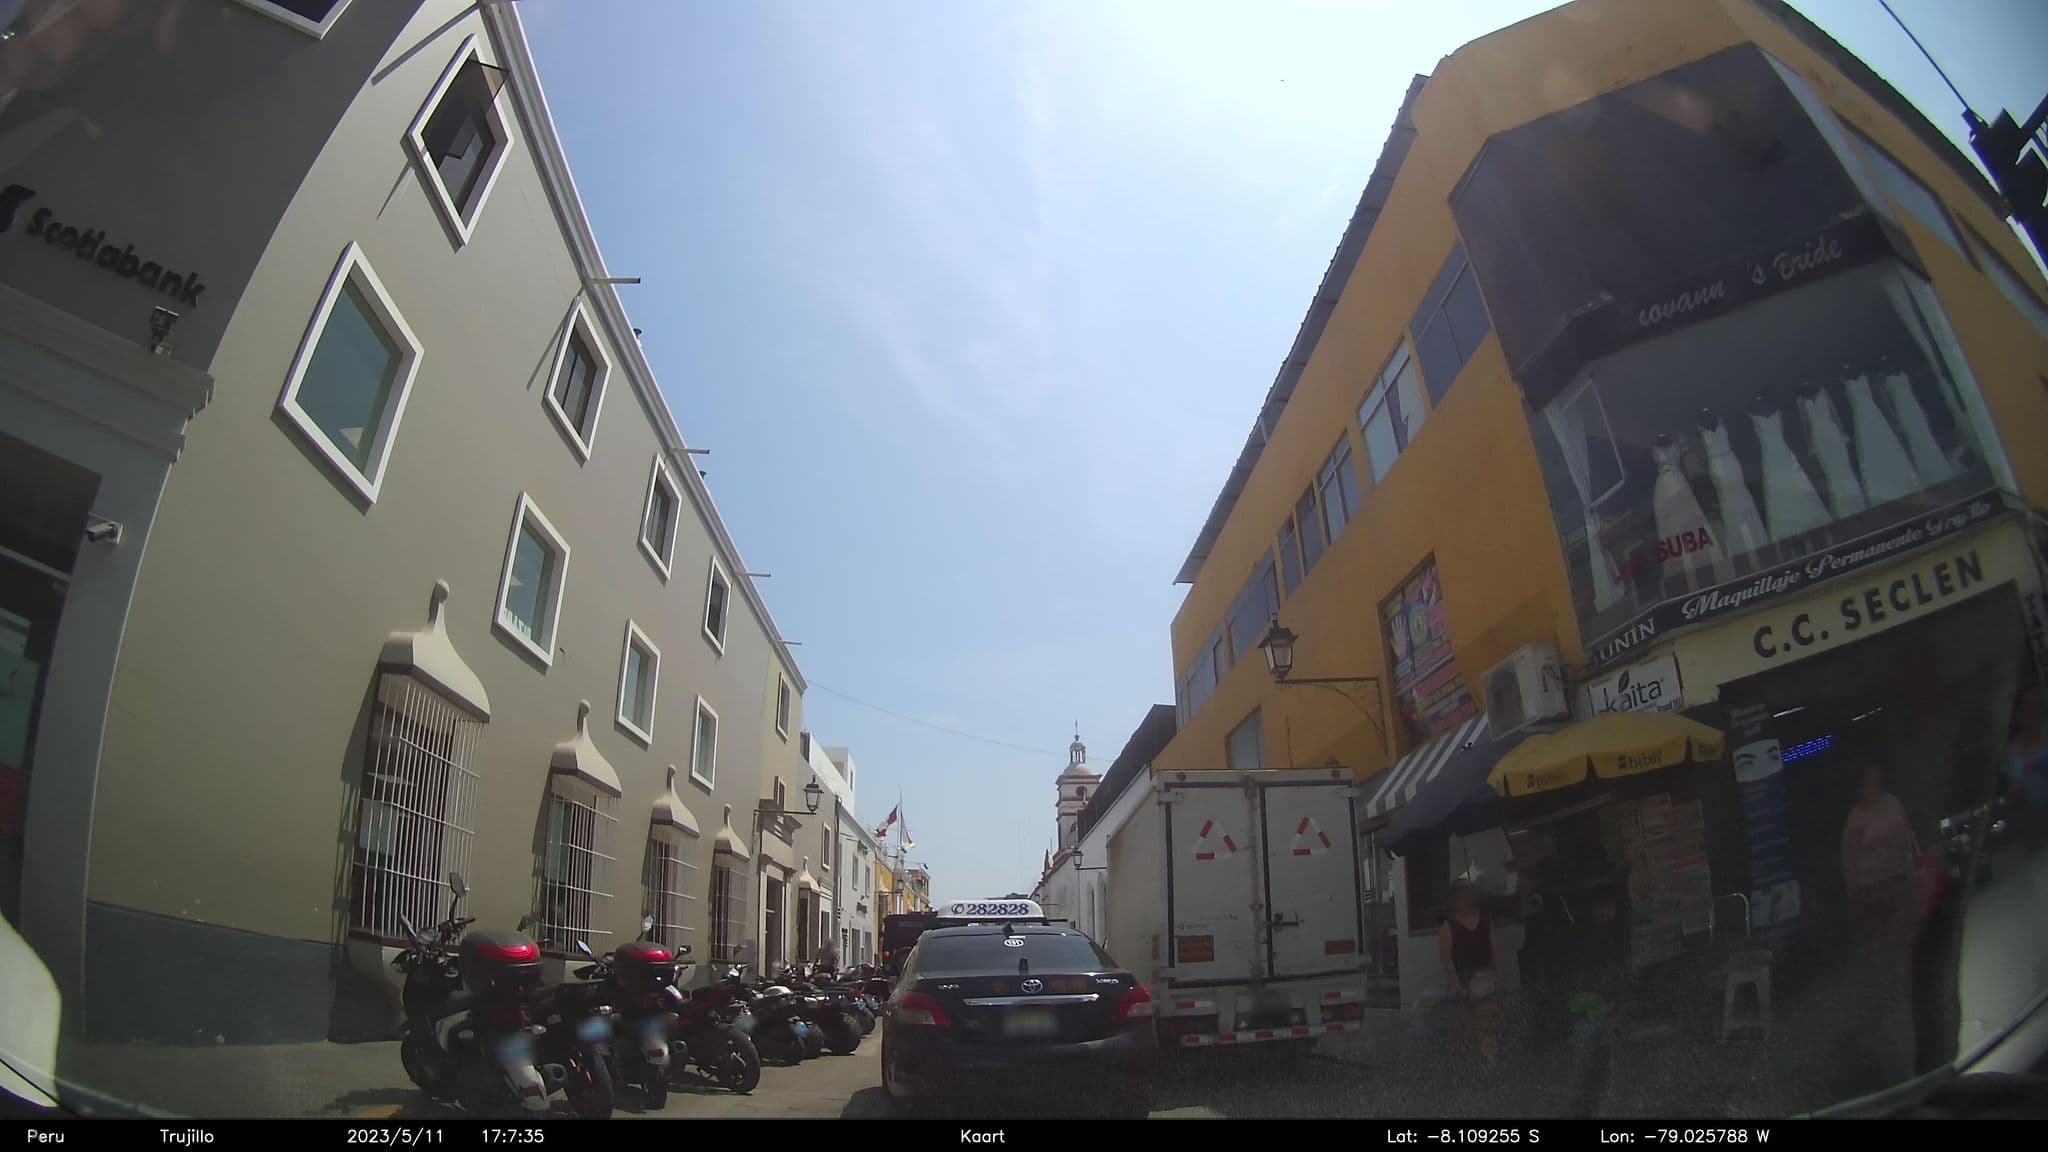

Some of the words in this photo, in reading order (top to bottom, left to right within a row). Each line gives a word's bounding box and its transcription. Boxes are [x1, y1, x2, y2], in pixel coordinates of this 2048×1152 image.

[26, 206, 206, 308] Scotiabank
[1655, 527, 1713, 563] SUBA
[1840, 549, 1984, 631] SECLEN
[966, 903, 1030, 916] 282828
